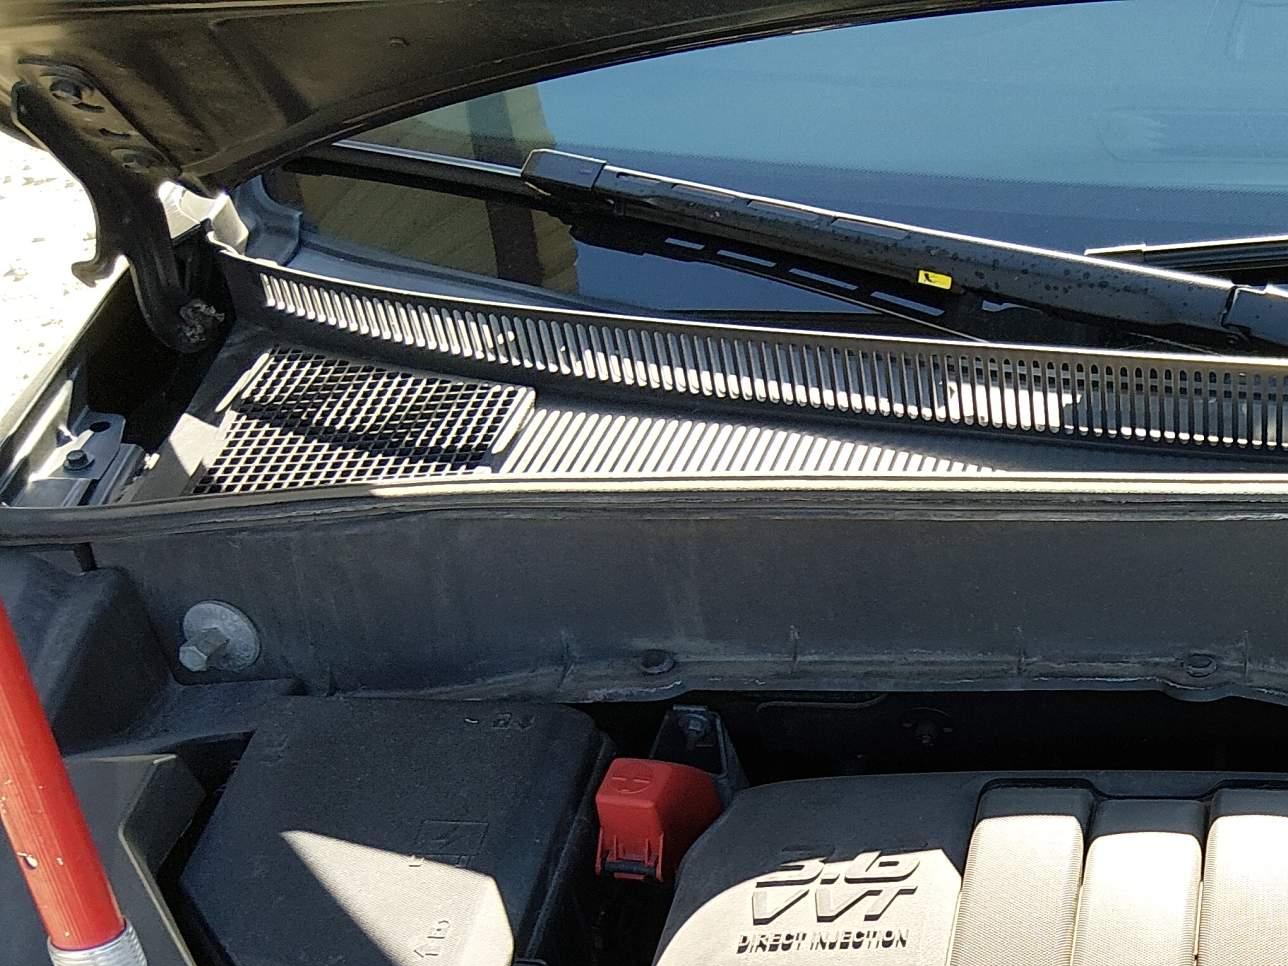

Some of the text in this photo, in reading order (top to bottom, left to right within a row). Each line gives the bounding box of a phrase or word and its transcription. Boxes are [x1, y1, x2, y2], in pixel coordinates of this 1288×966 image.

[752, 887, 918, 925] VVT
[736, 928, 909, 954] DIRECT INJECTION
